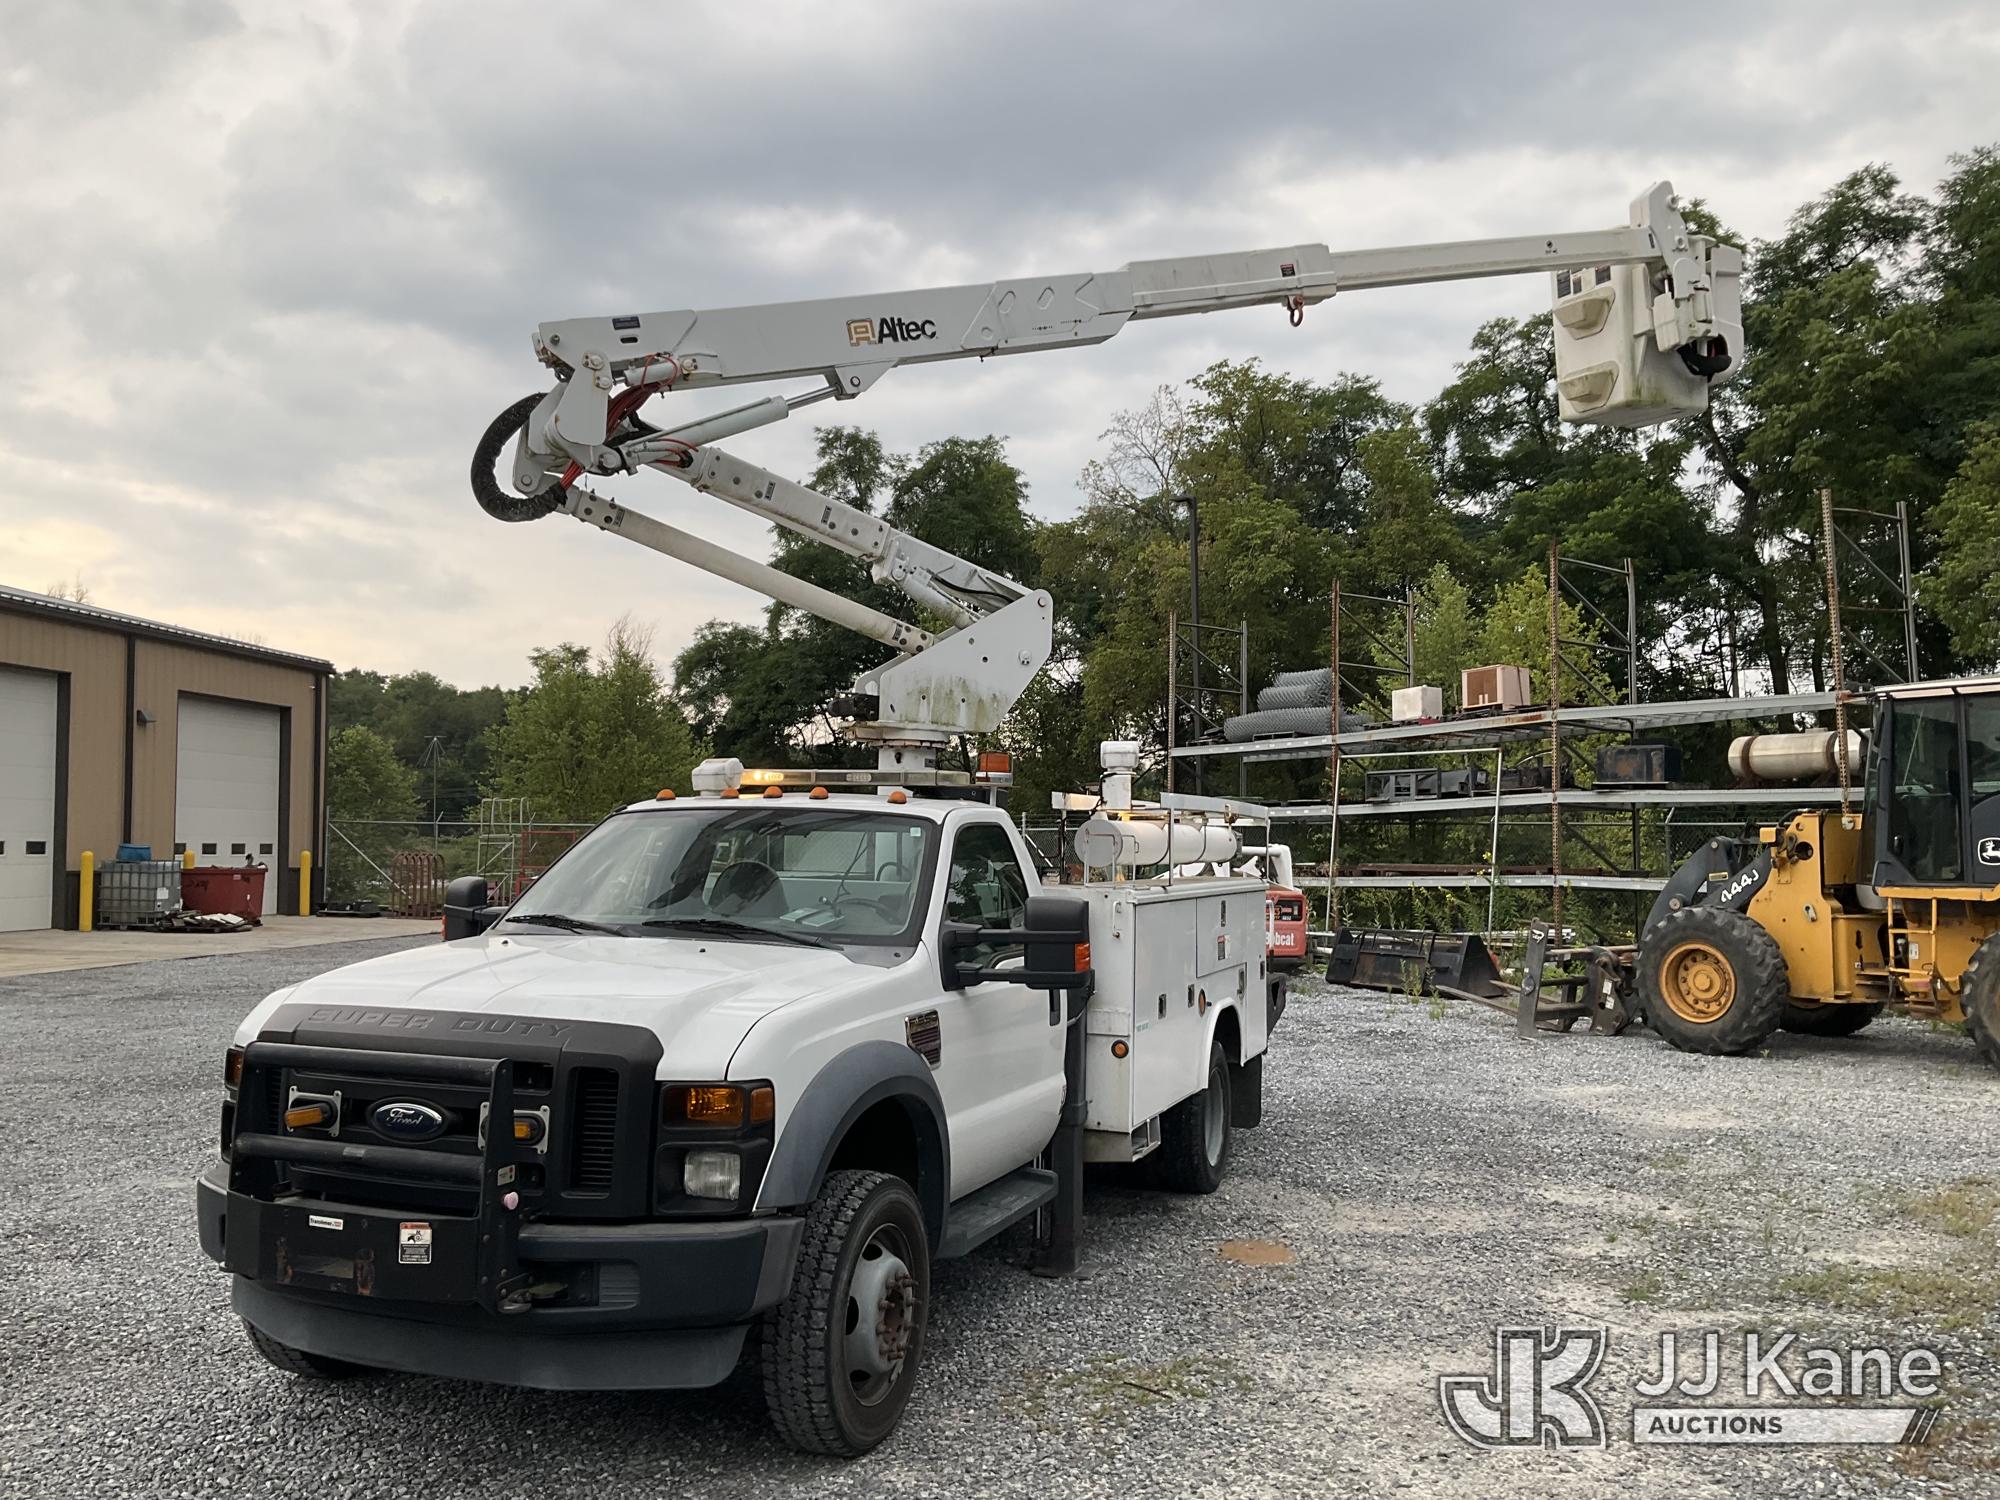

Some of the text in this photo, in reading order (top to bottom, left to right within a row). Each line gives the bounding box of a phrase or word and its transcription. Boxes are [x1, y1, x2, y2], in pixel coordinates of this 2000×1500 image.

[878, 316, 937, 344] Altec
[1265, 931, 1296, 946] Bbcat
[308, 1008, 575, 1038] SUPER DUTY
